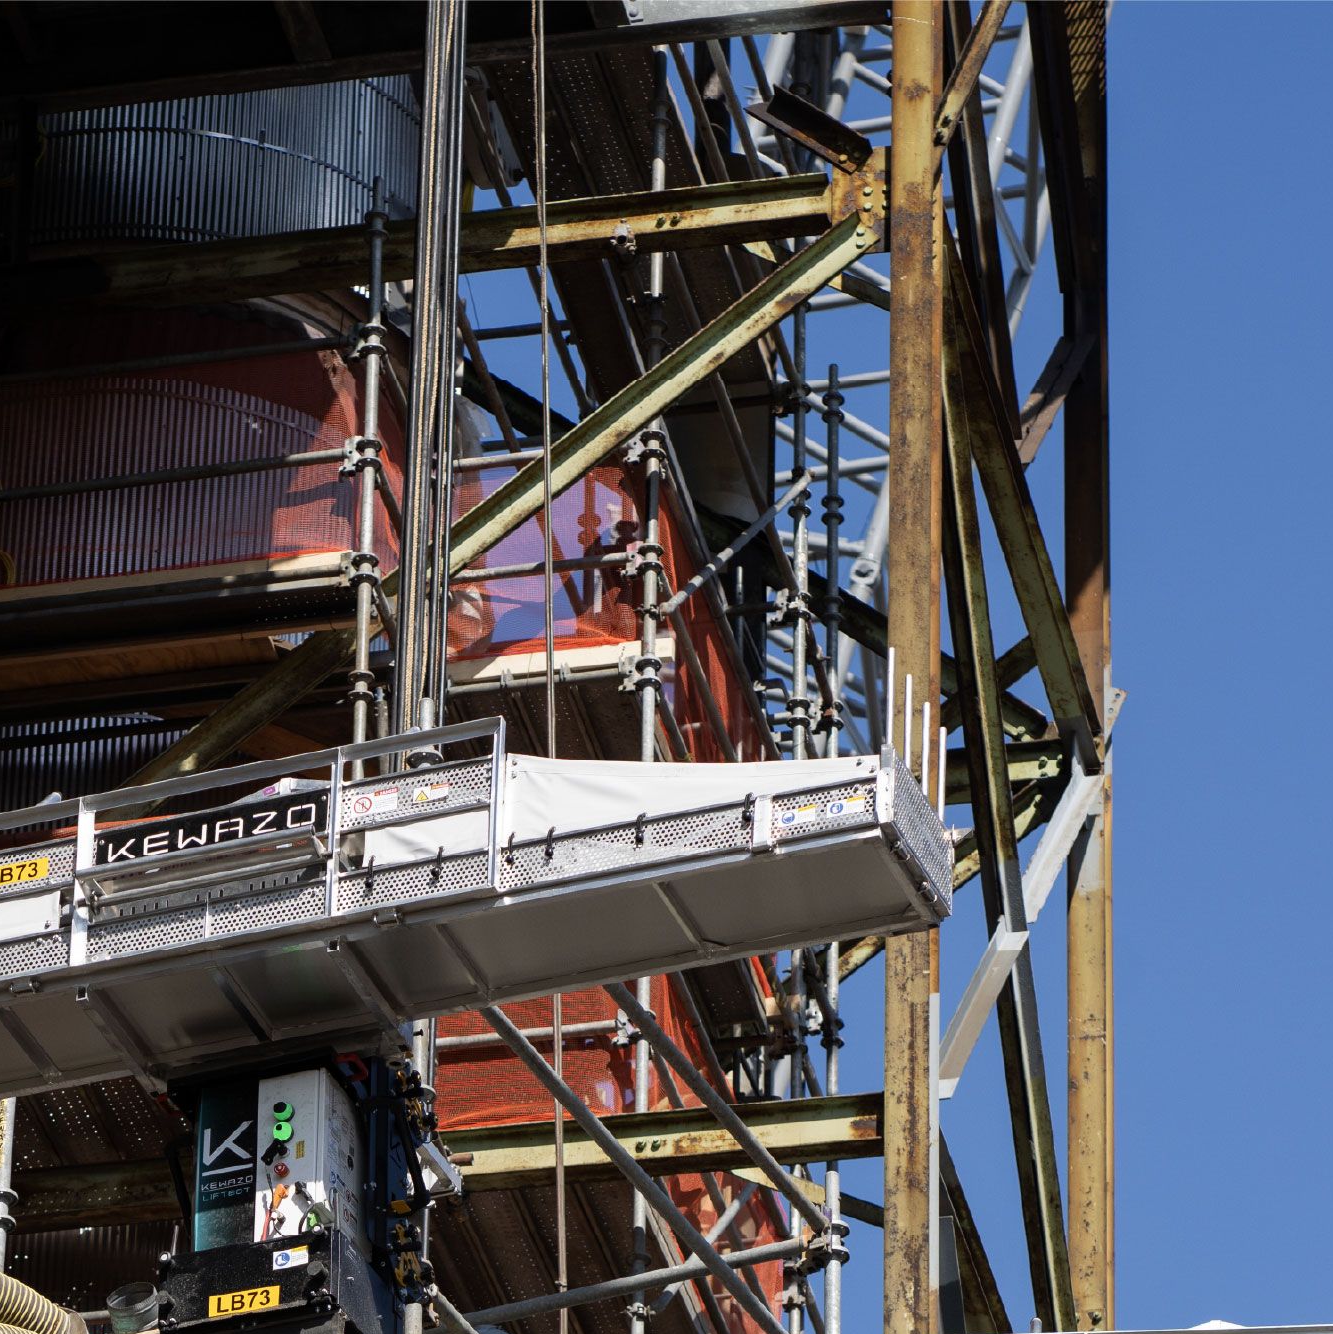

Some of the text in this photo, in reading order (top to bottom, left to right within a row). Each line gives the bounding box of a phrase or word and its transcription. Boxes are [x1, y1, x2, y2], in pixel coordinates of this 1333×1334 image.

[107, 803, 316, 863] KEWAZO
[201, 1174, 254, 1191] KEWAZO
[202, 1186, 251, 1202] LIFTBOT
[216, 1289, 271, 1313] LB73
